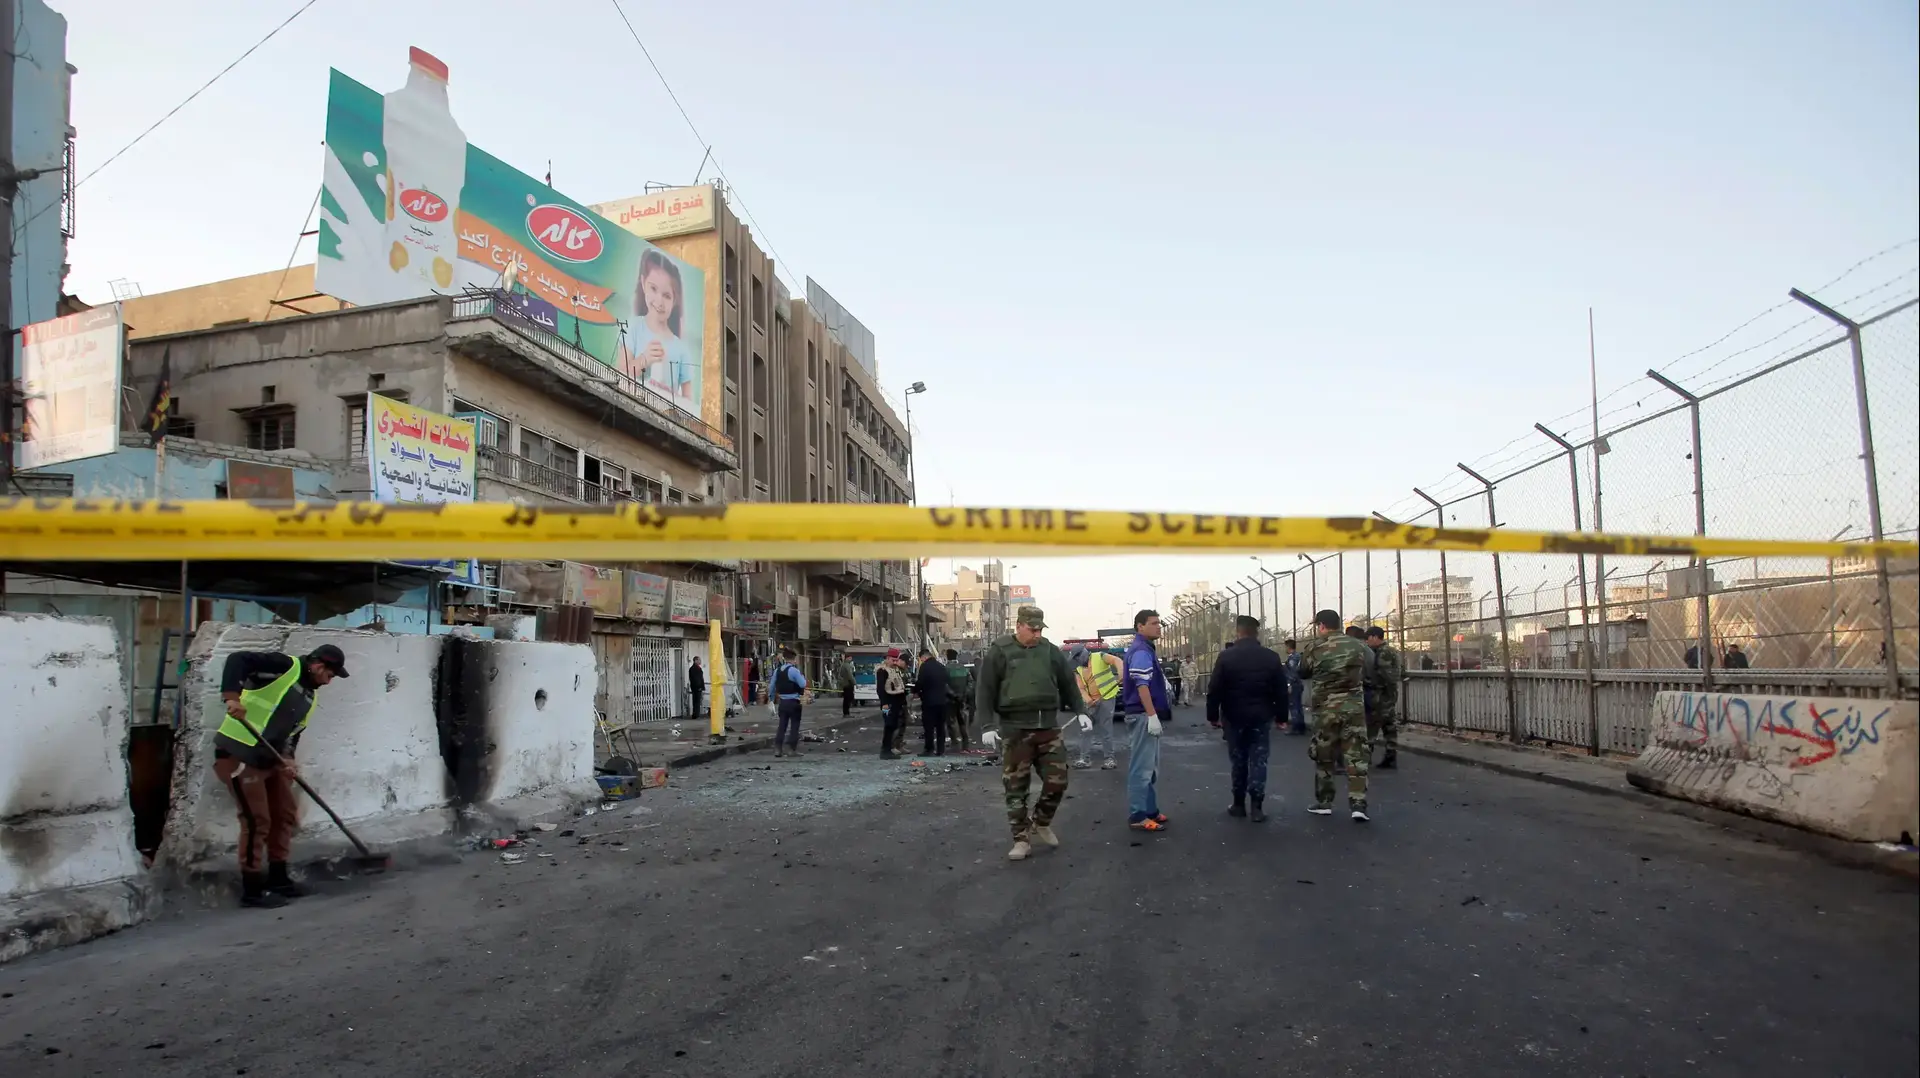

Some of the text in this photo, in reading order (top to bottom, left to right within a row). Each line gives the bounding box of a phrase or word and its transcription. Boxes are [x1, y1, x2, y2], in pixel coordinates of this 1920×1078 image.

[620, 199, 665, 225] الهجان
[668, 194, 704, 217] فندق
[410, 223, 433, 237] حليب
[570, 290, 601, 311] شكل
[377, 410, 470, 453] محلات الشمري
[390, 440, 462, 476] لبيع المواد
[380, 461, 422, 491] والصحية
[929, 507, 1281, 535] CRIME SCENE
